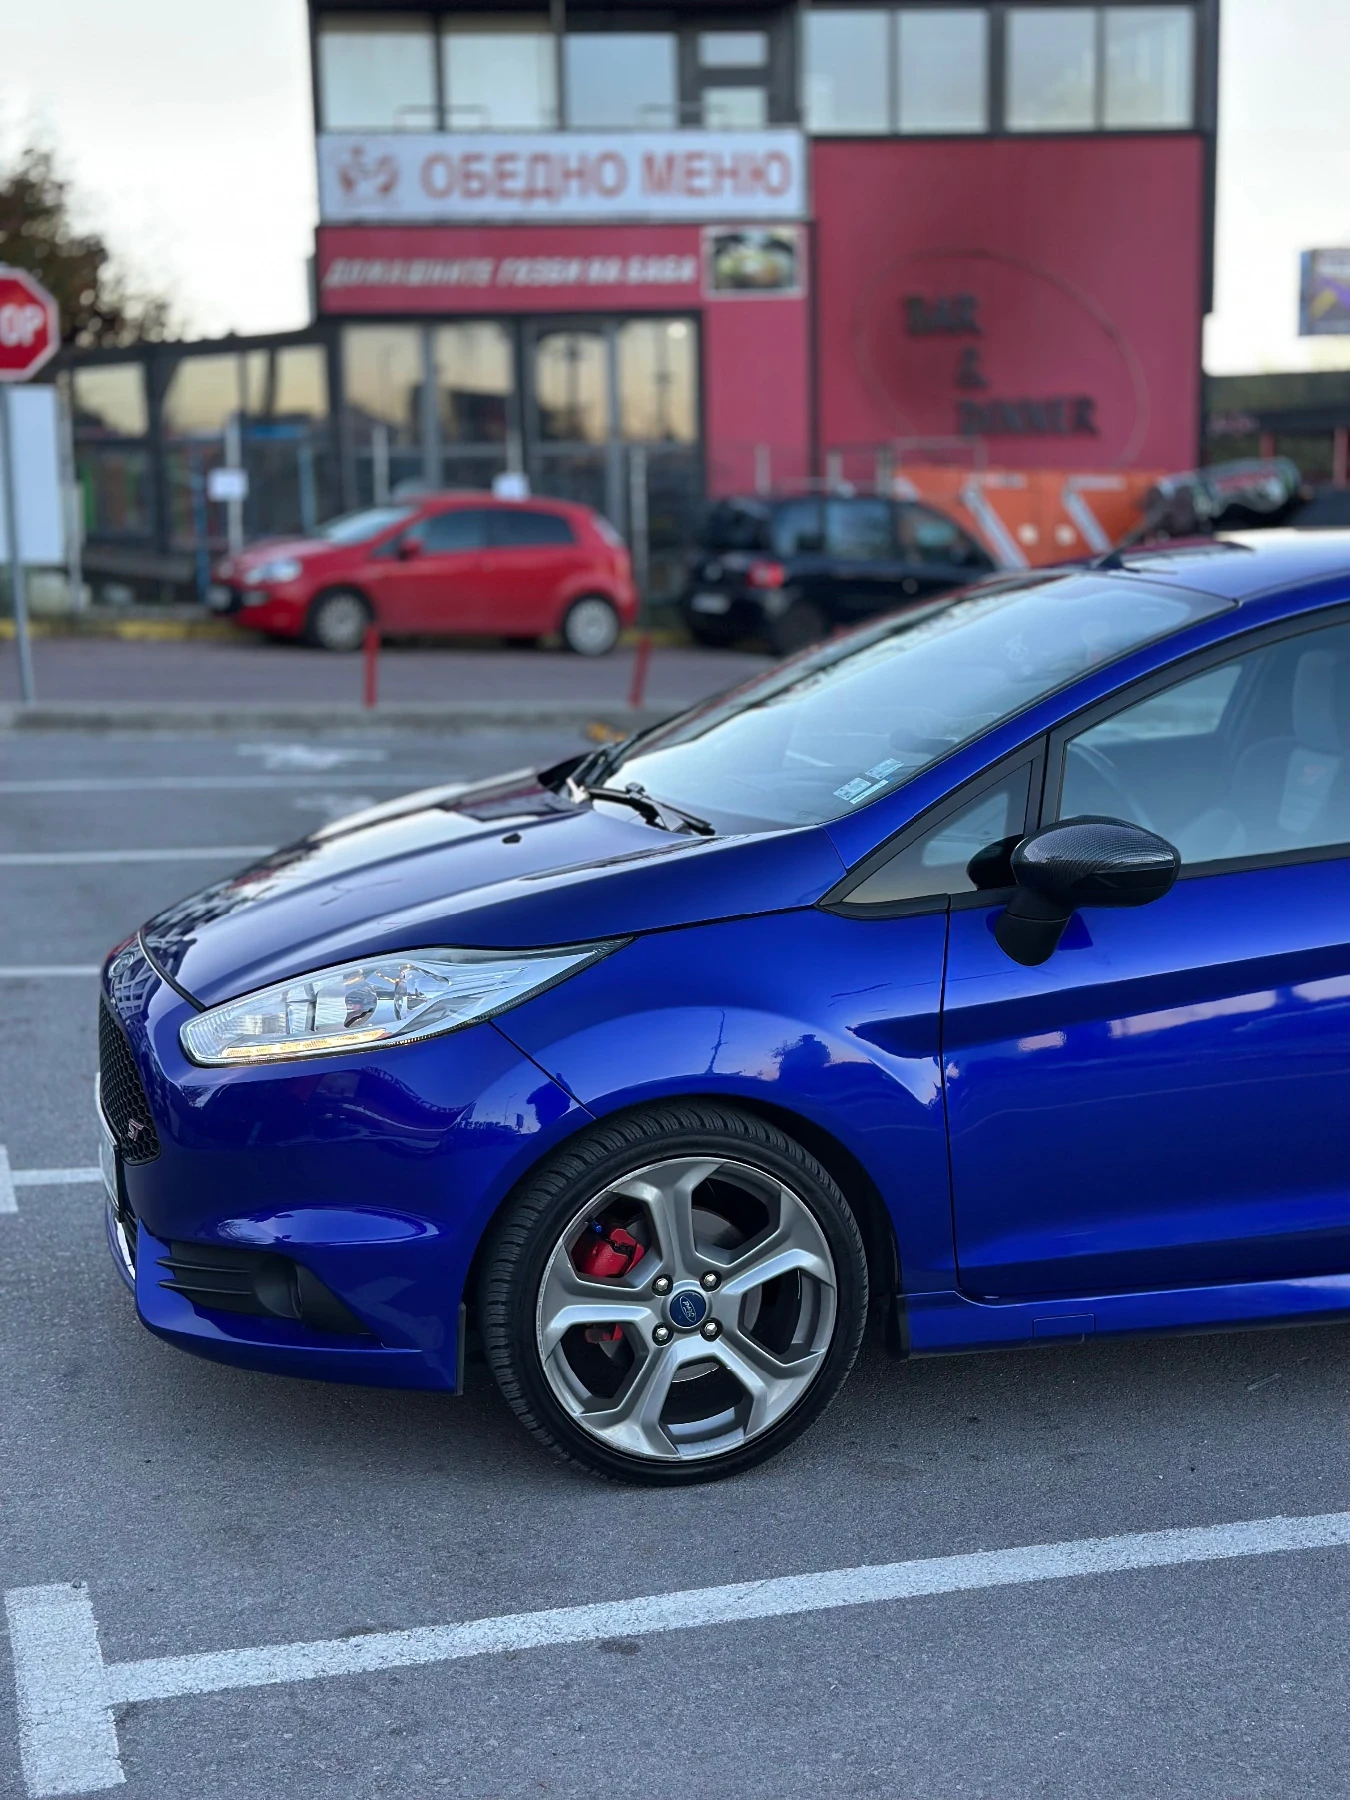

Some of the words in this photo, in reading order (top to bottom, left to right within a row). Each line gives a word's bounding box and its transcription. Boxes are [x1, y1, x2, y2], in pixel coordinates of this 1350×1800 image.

[419, 151, 628, 204] ОБЕДНО
[641, 150, 793, 197] МЕНЮ
[906, 296, 981, 336] BAR
[959, 395, 1099, 438] DINNER
